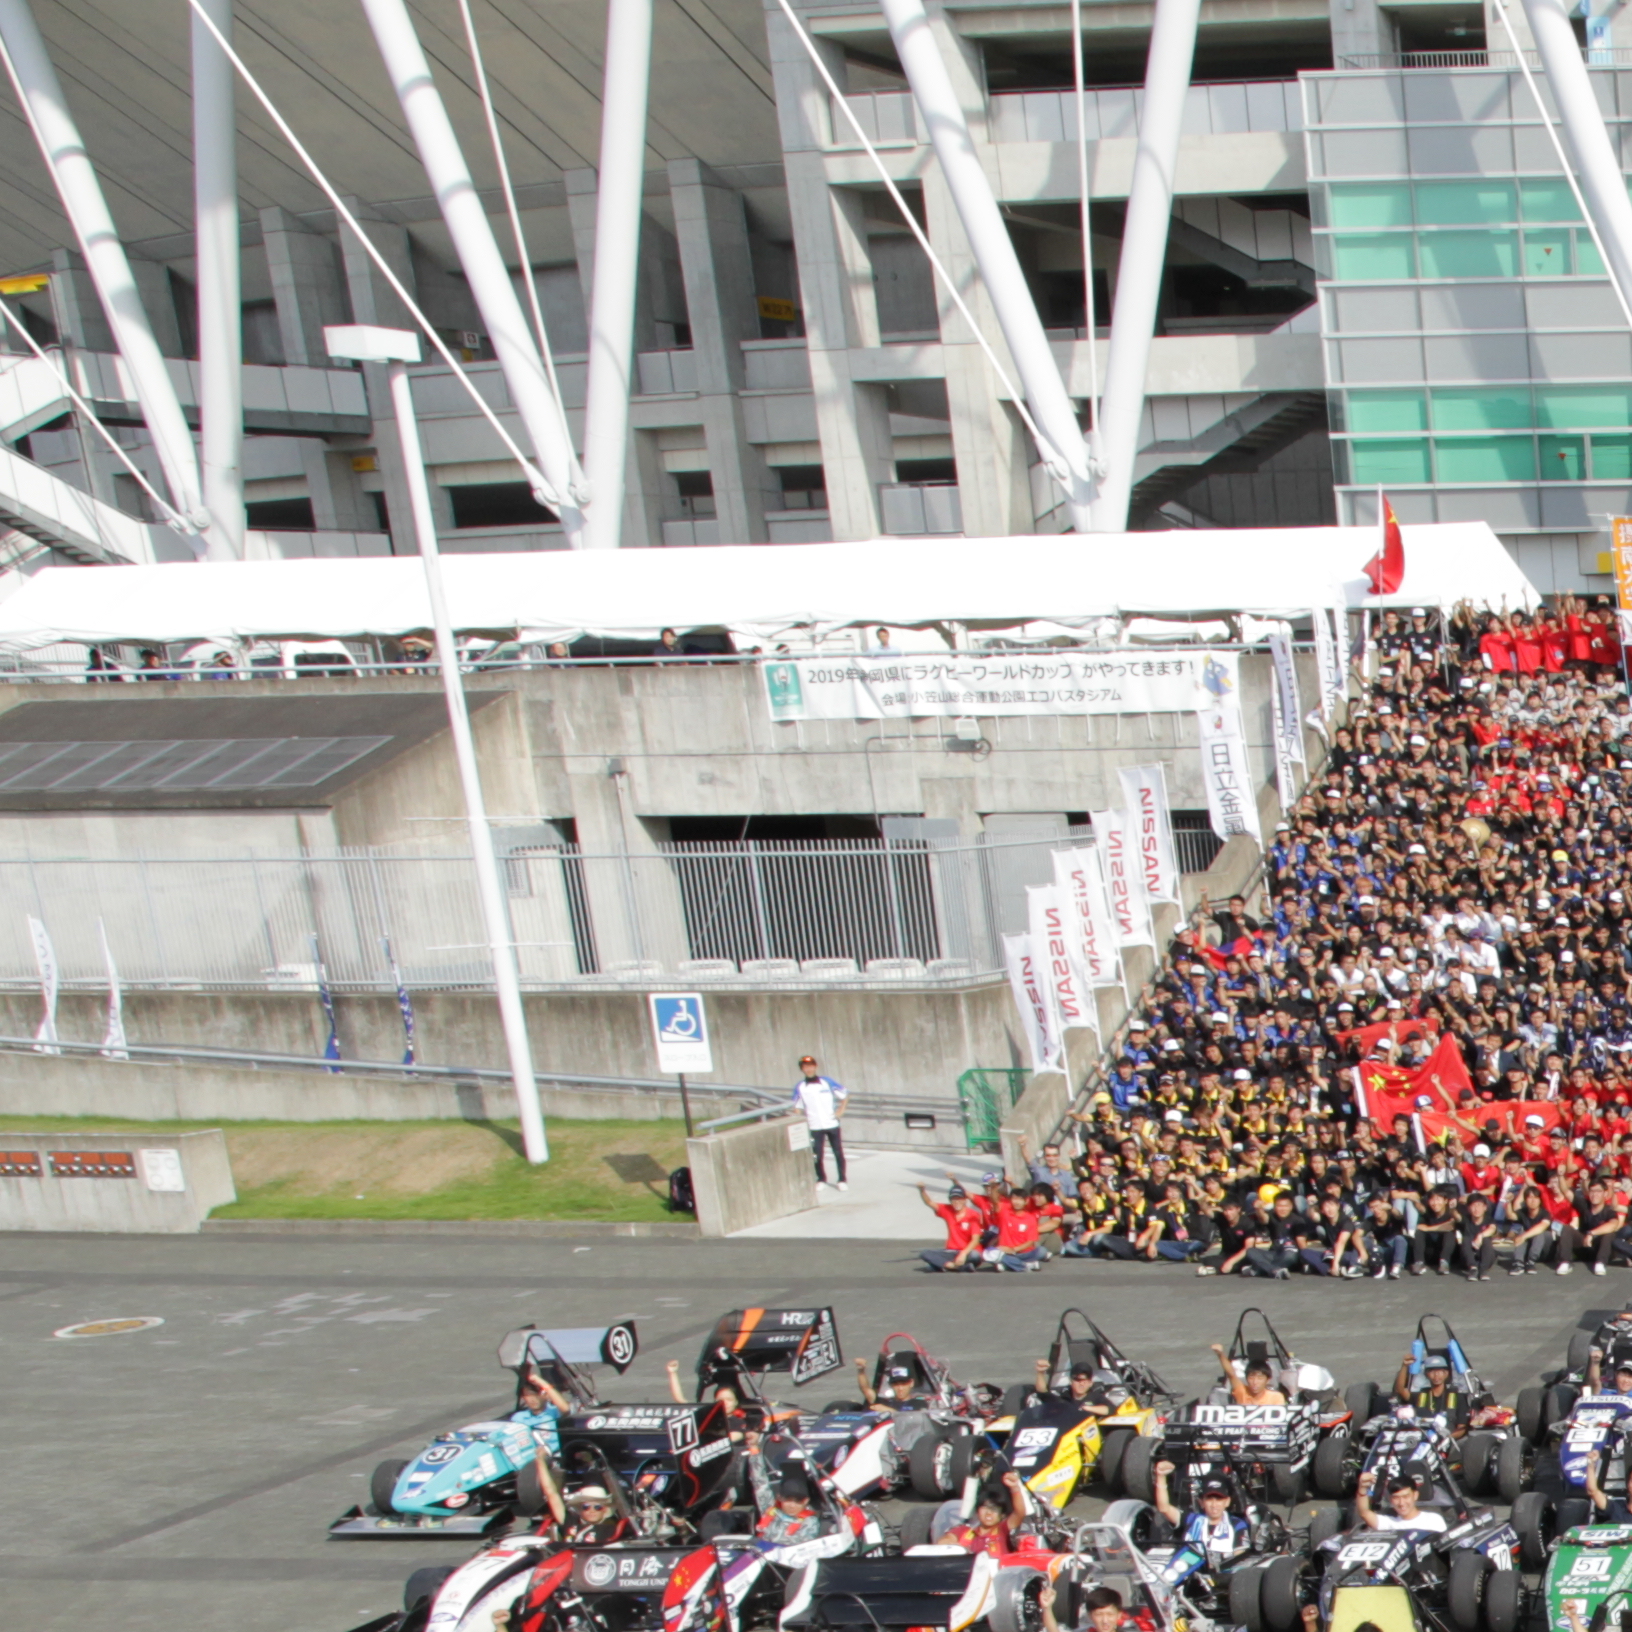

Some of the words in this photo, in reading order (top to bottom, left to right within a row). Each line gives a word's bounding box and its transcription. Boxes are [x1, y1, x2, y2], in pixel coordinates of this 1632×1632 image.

[1139, 787, 1161, 892] NISSAN
[611, 1330, 630, 1361] 31
[672, 1418, 696, 1448] 77
[1020, 1430, 1051, 1446] 53
[1568, 1428, 1604, 1443] E1
[1341, 1543, 1386, 1561] E12
[1574, 1557, 1608, 1574] 51
